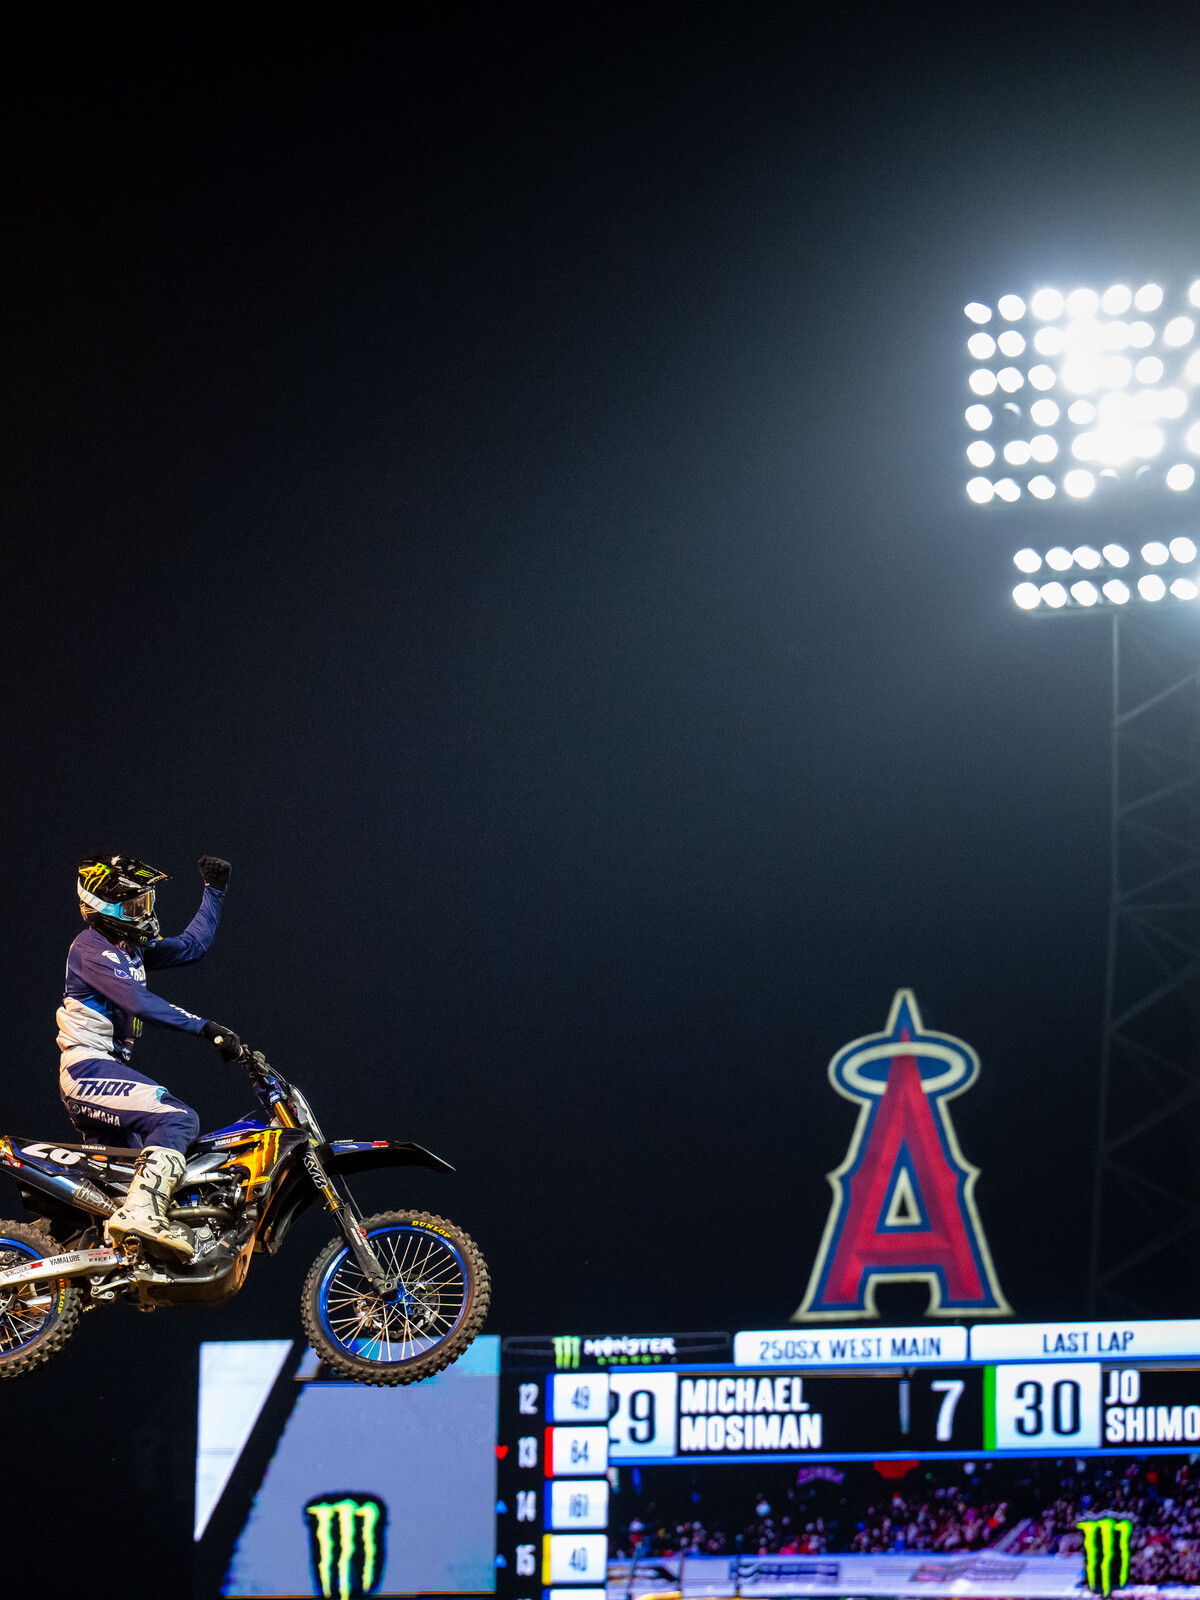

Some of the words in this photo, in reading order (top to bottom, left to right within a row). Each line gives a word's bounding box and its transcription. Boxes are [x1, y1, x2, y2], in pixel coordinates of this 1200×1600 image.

[76, 1080, 137, 1097] THOR
[80, 1105, 121, 1127] YAMAHA
[411, 1220, 451, 1239] DUNLOP
[49, 1254, 81, 1266] YAMALUBE
[584, 1337, 677, 1357] MONSTER
[759, 1340, 821, 1360] 250SX
[830, 1338, 882, 1358] WEST
[891, 1336, 941, 1356] MAIN
[1042, 1332, 1089, 1353] LAST
[1098, 1330, 1134, 1351] LAP
[519, 1383, 539, 1415] 12
[680, 1377, 810, 1414] MICHAEL
[1105, 1369, 1141, 1405] JO
[930, 1379, 965, 1442] 7
[1014, 1379, 1081, 1437] 30
[1105, 1406, 1200, 1442] SHIMO
[680, 1414, 822, 1451] MOSIMAN
[518, 1436, 538, 1468] 13
[570, 1439, 589, 1464] 64
[516, 1490, 537, 1522] 14
[516, 1544, 536, 1576] 15
[569, 1547, 588, 1573] 40
